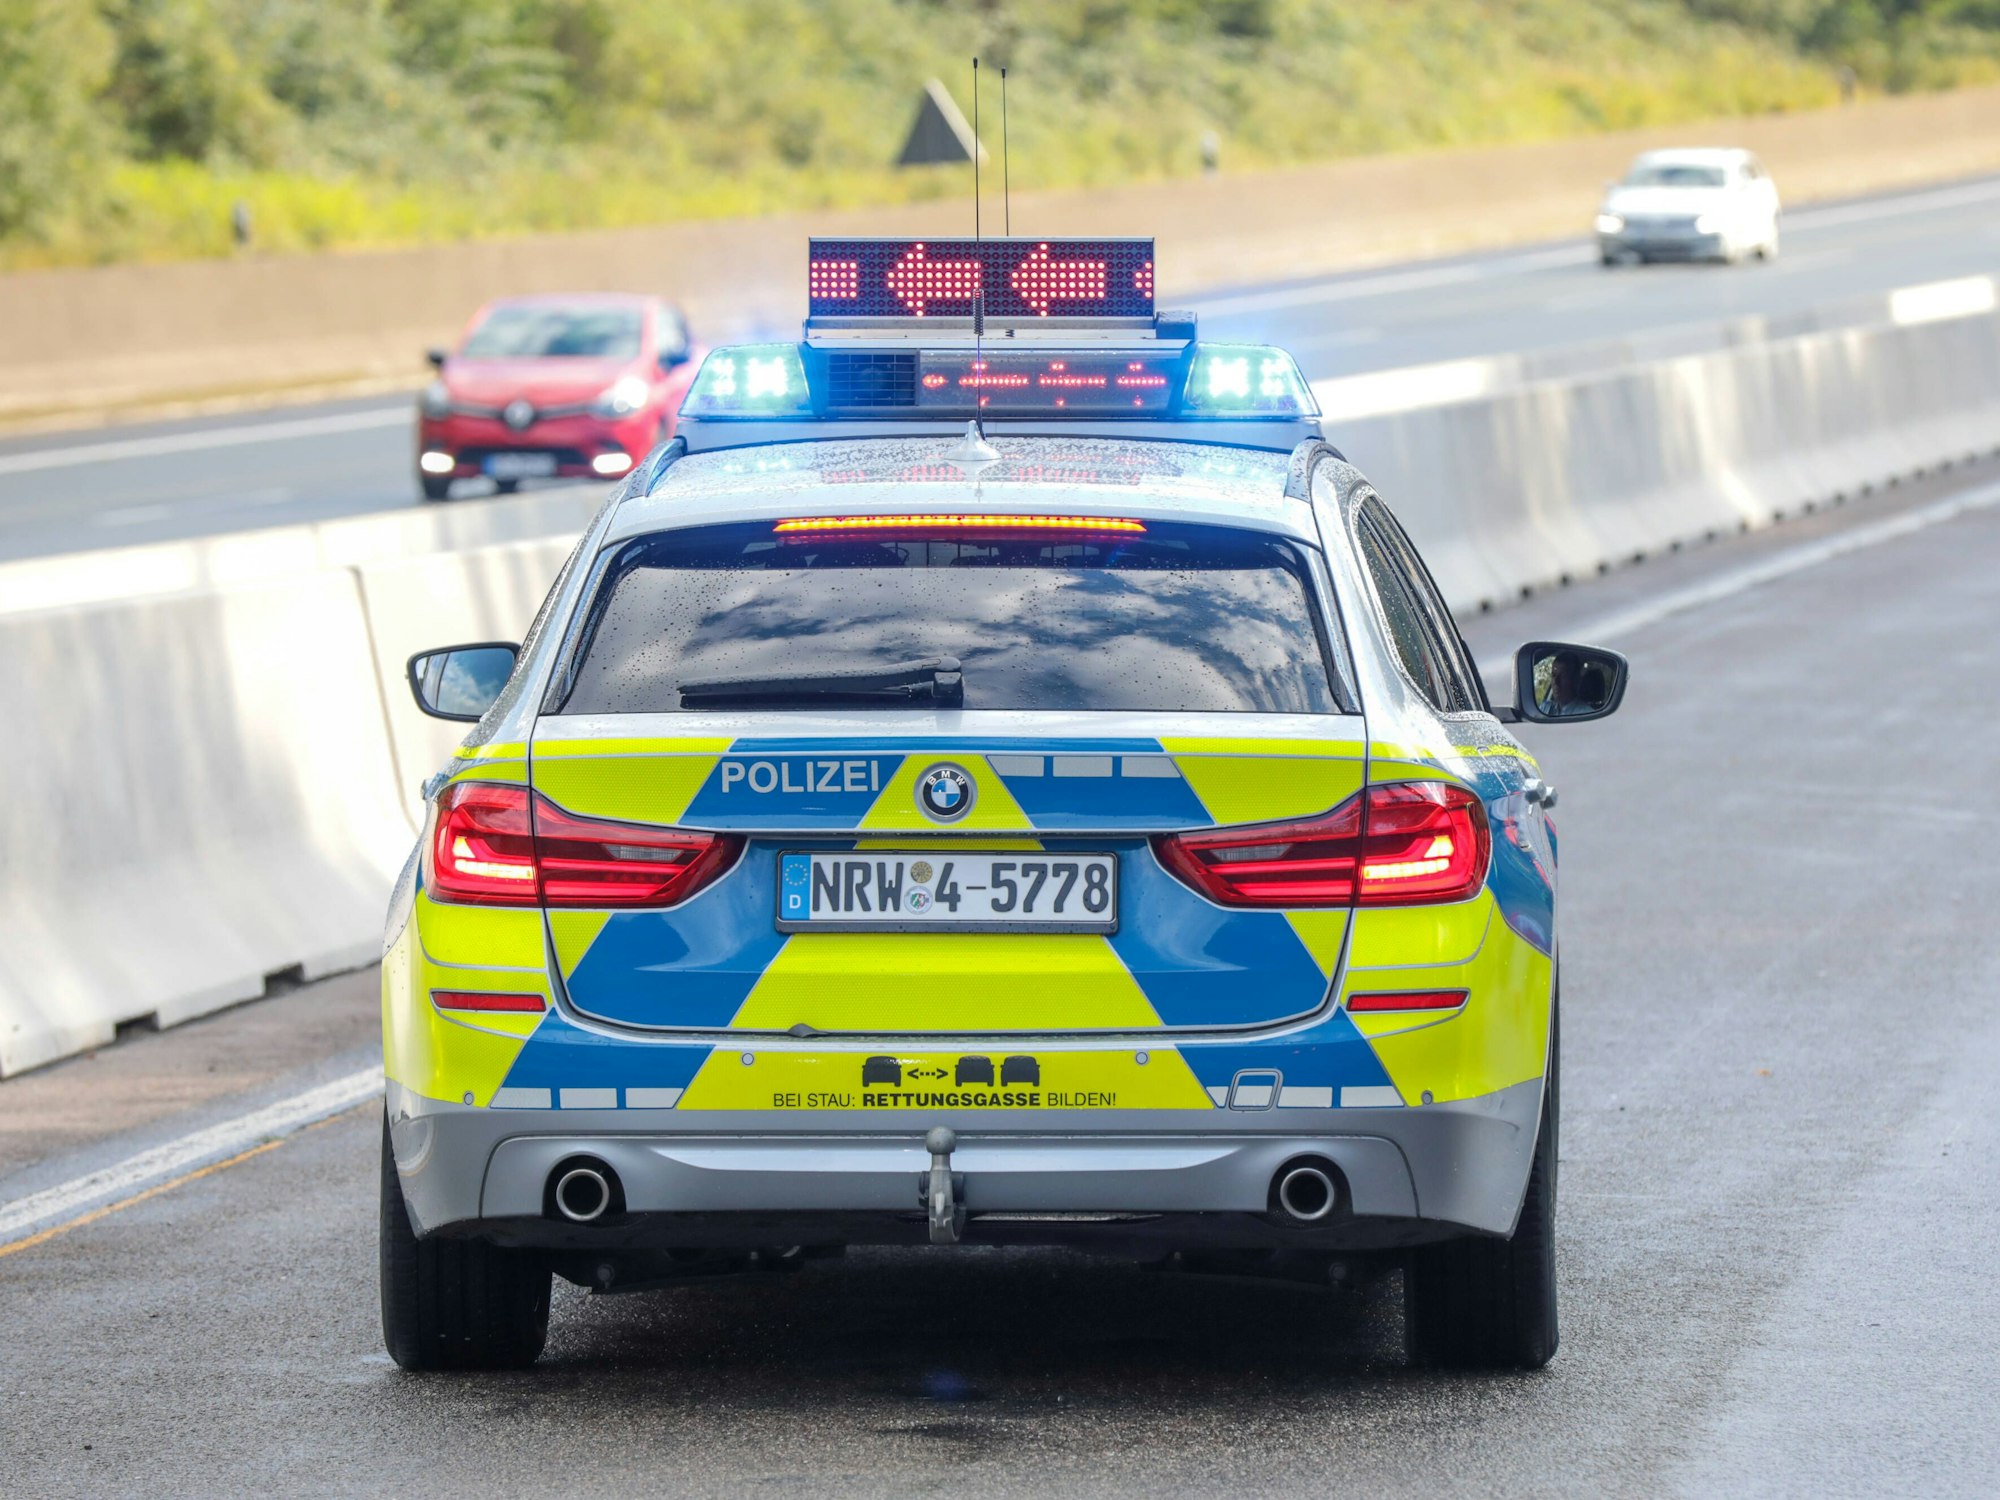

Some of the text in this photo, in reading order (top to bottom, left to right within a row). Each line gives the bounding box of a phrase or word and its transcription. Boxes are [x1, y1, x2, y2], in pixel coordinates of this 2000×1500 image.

[720, 760, 880, 794] POLIZEI
[926, 769, 966, 786] BMW
[812, 861, 1109, 913] NRW 4-5778
[788, 894, 801, 909] D
[774, 1092, 1116, 1107] BEI STAU: RETTUNGSGASSE BILDEN!
